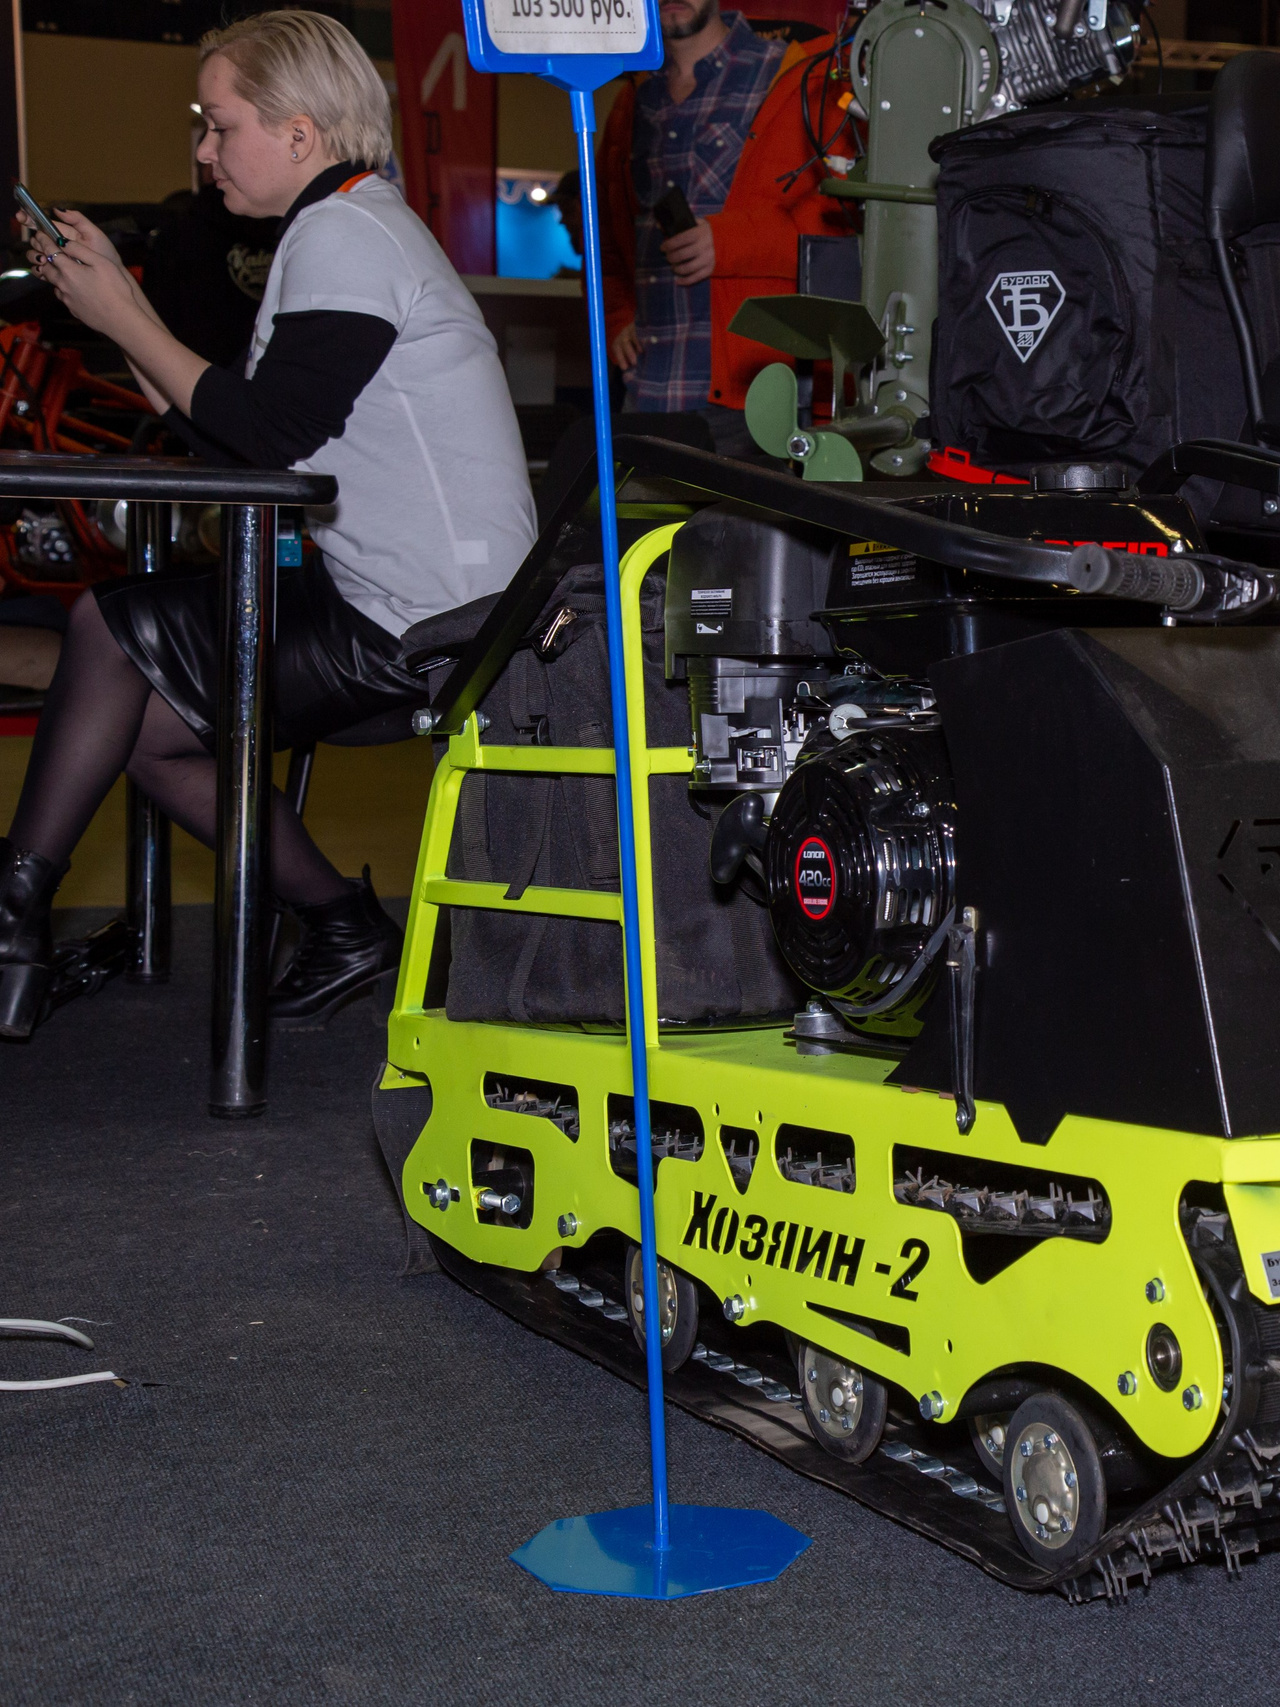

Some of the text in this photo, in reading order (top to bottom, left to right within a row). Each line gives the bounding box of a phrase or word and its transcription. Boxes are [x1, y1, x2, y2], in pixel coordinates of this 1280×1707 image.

[512, 0, 543, 17] 103
[550, 0, 584, 18] 500
[1001, 275, 1050, 287] БУРЛАК
[681, 1190, 866, 1287] ХОЗЯИН
